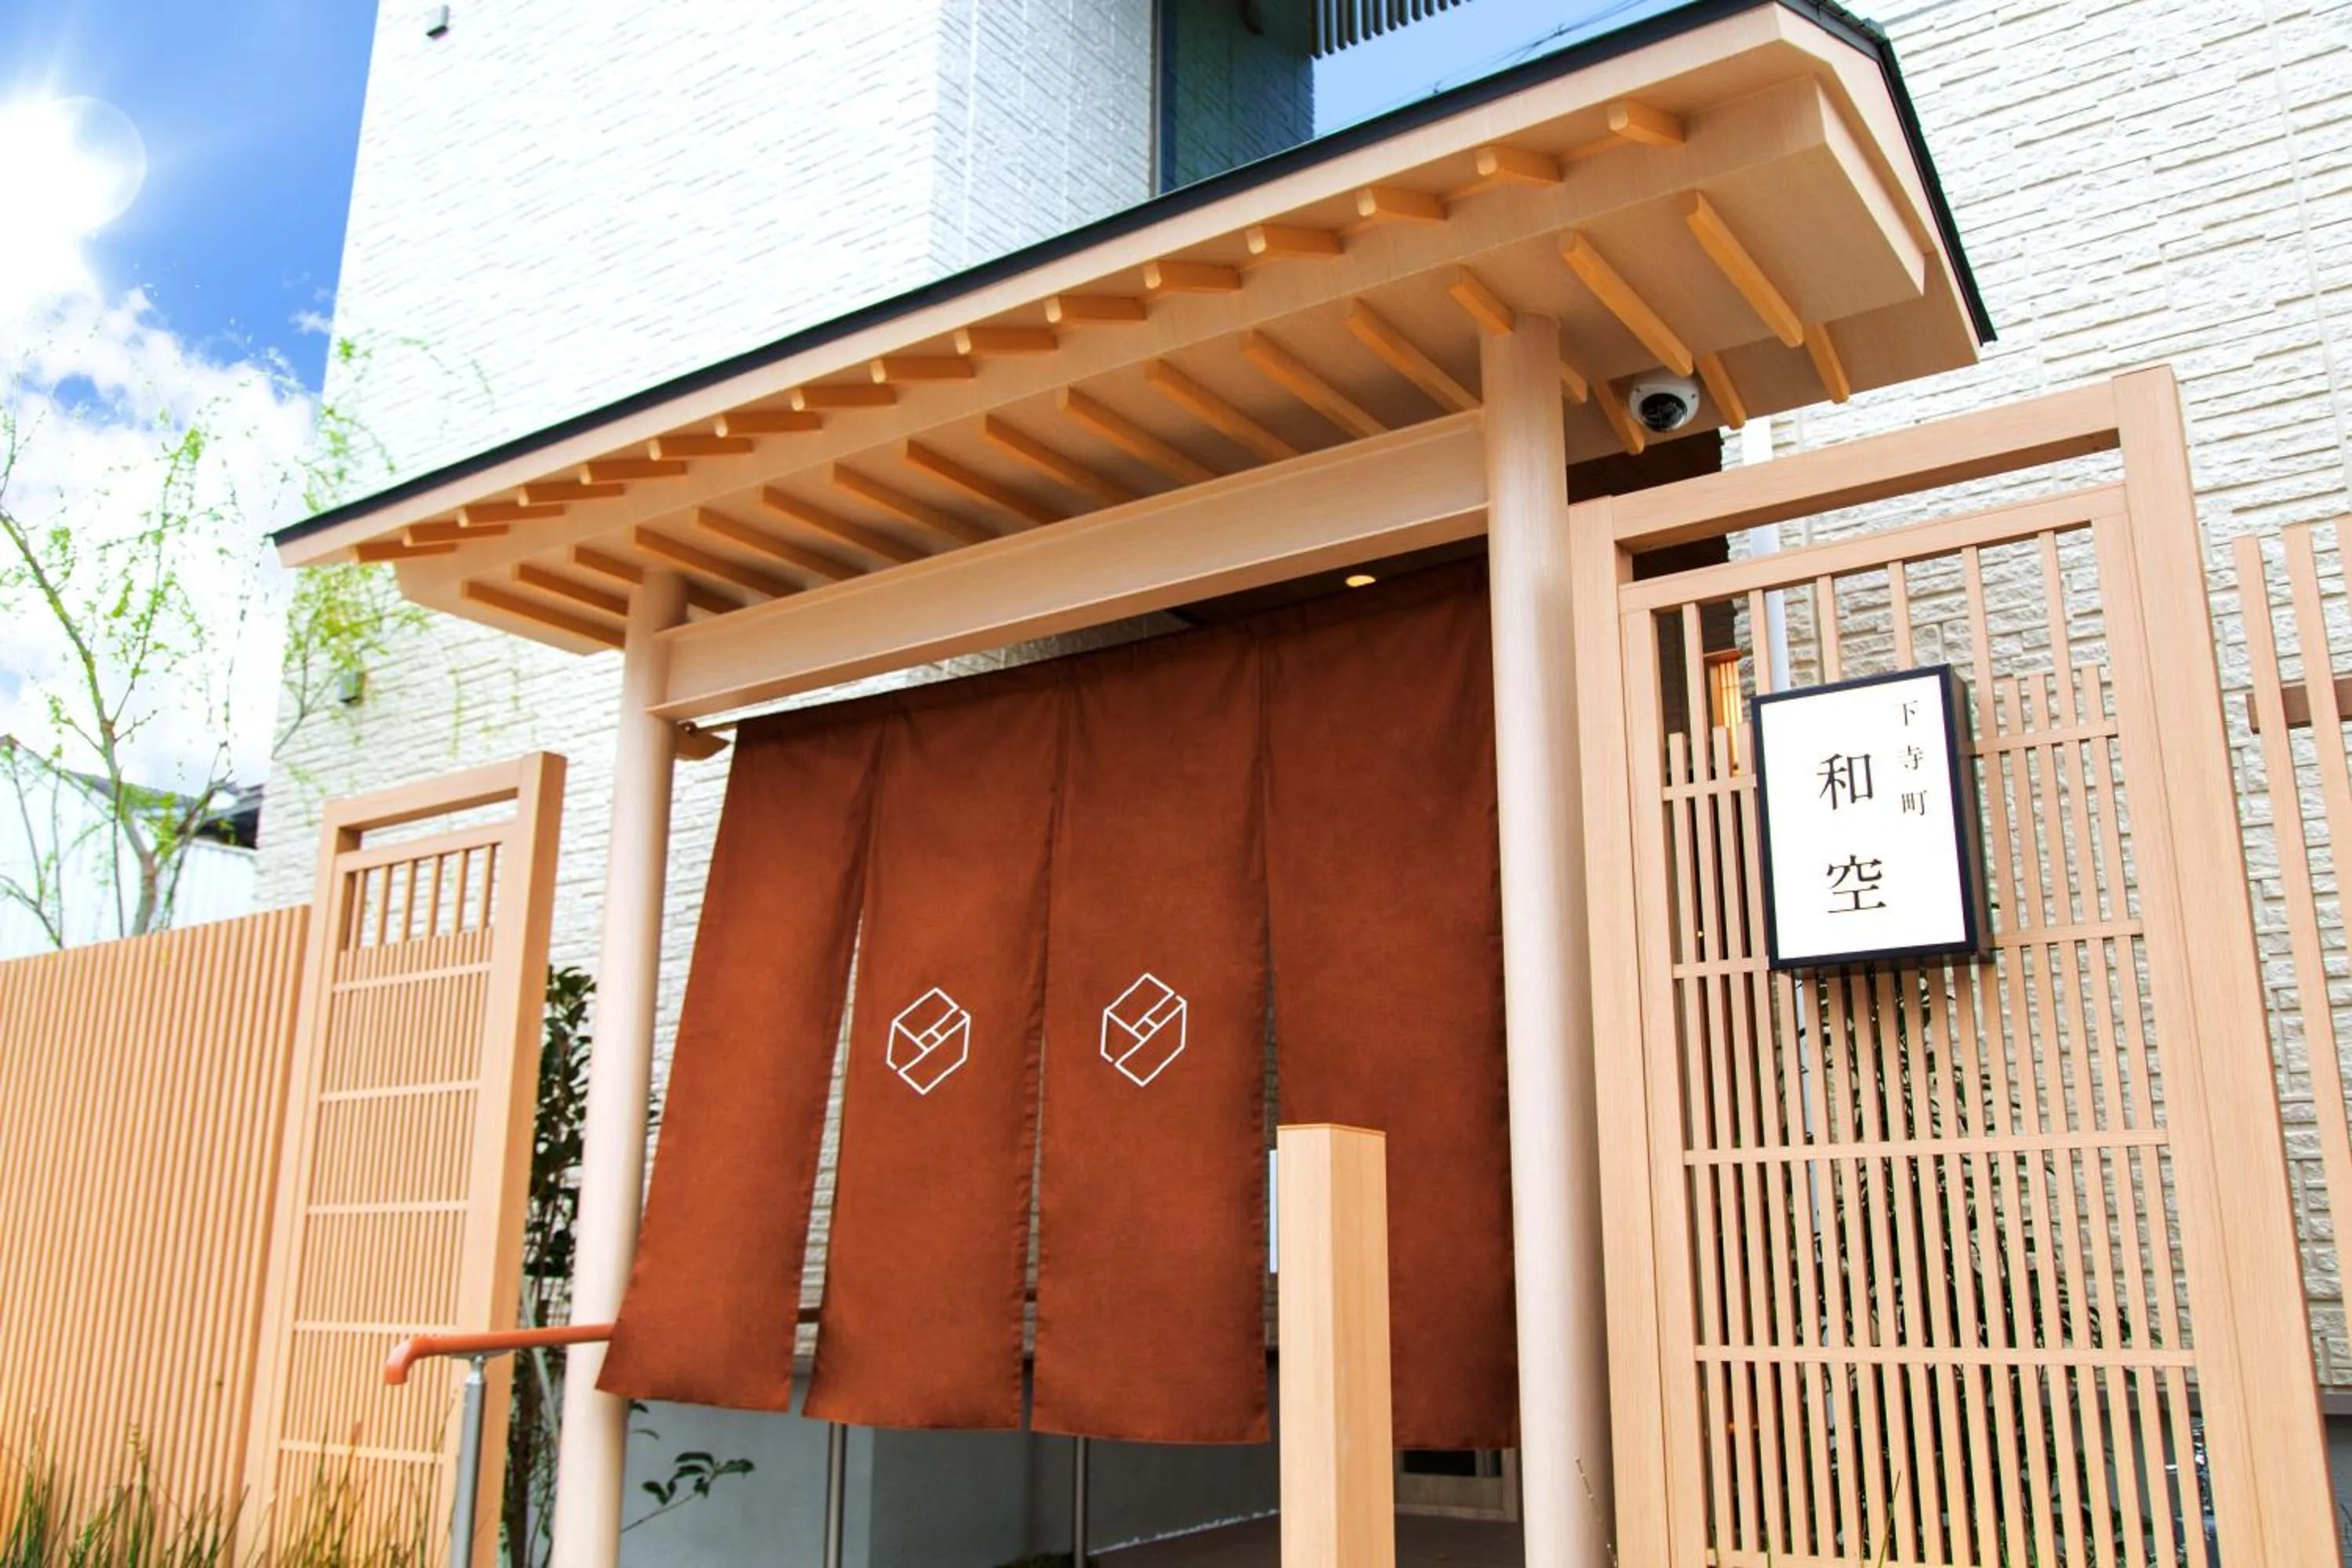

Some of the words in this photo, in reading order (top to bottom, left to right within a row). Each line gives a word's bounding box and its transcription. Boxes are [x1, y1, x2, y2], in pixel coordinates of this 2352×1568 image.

[1897, 700, 1927, 816] 下寺町
[1817, 753, 1886, 913] 和空
